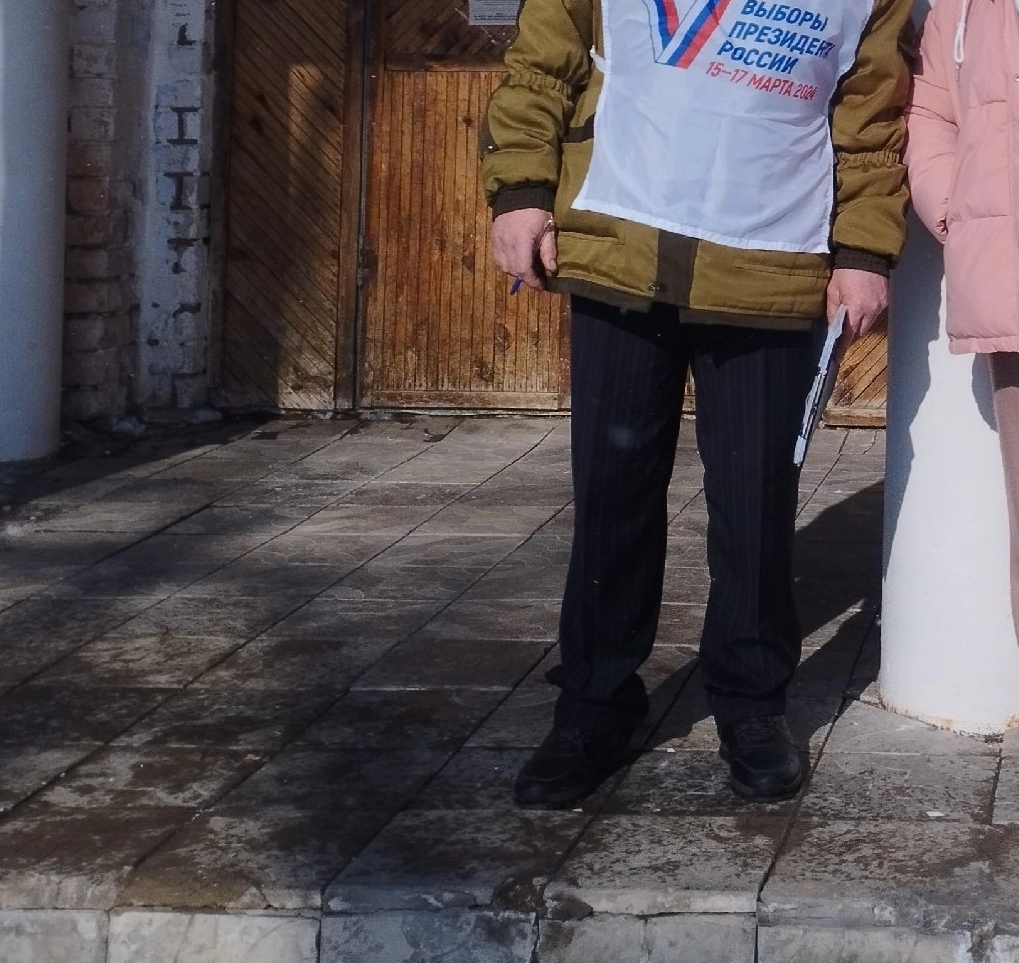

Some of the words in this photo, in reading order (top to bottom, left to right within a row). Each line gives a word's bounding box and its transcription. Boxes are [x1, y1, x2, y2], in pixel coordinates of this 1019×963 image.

[717, 40, 799, 74] РОССИИ
[749, 74, 793, 97] МАРТА
[793, 83, 818, 100] 2024
